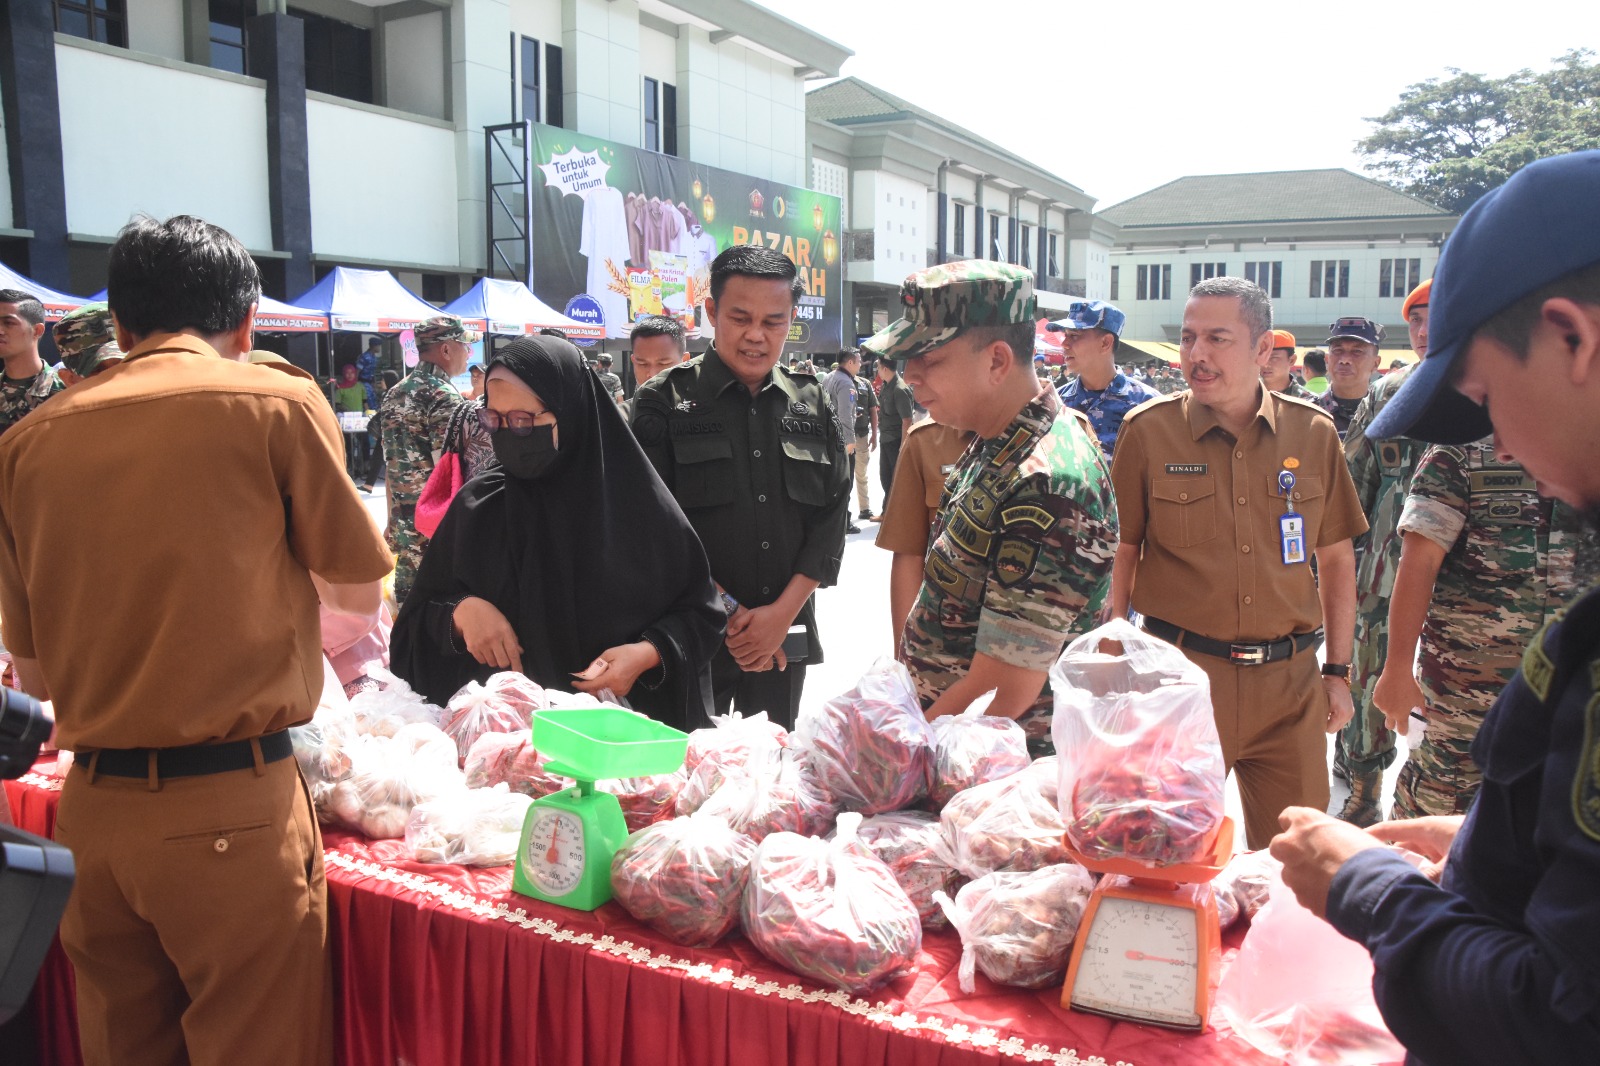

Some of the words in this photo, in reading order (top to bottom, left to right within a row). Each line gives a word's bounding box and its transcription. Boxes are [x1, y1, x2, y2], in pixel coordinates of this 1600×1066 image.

[552, 155, 597, 174] Terbuka
[562, 168, 589, 183] untuk
[572, 178, 602, 192] Umum
[733, 226, 812, 268] BAZAR
[630, 275, 651, 284] FILMA
[661, 275, 678, 283] Pulen
[571, 308, 598, 318] Murah
[796, 306, 814, 319] 445
[816, 307, 823, 320] H
[253, 318, 288, 327] AHANAN
[289, 319, 325, 328] PANGAN
[388, 321, 411, 330] DINAS
[781, 418, 824, 434] KADIS
[1483, 475, 1524, 486] DEDDY
[569, 852, 583, 862] 500
[1098, 946, 1109, 954] 1.5
